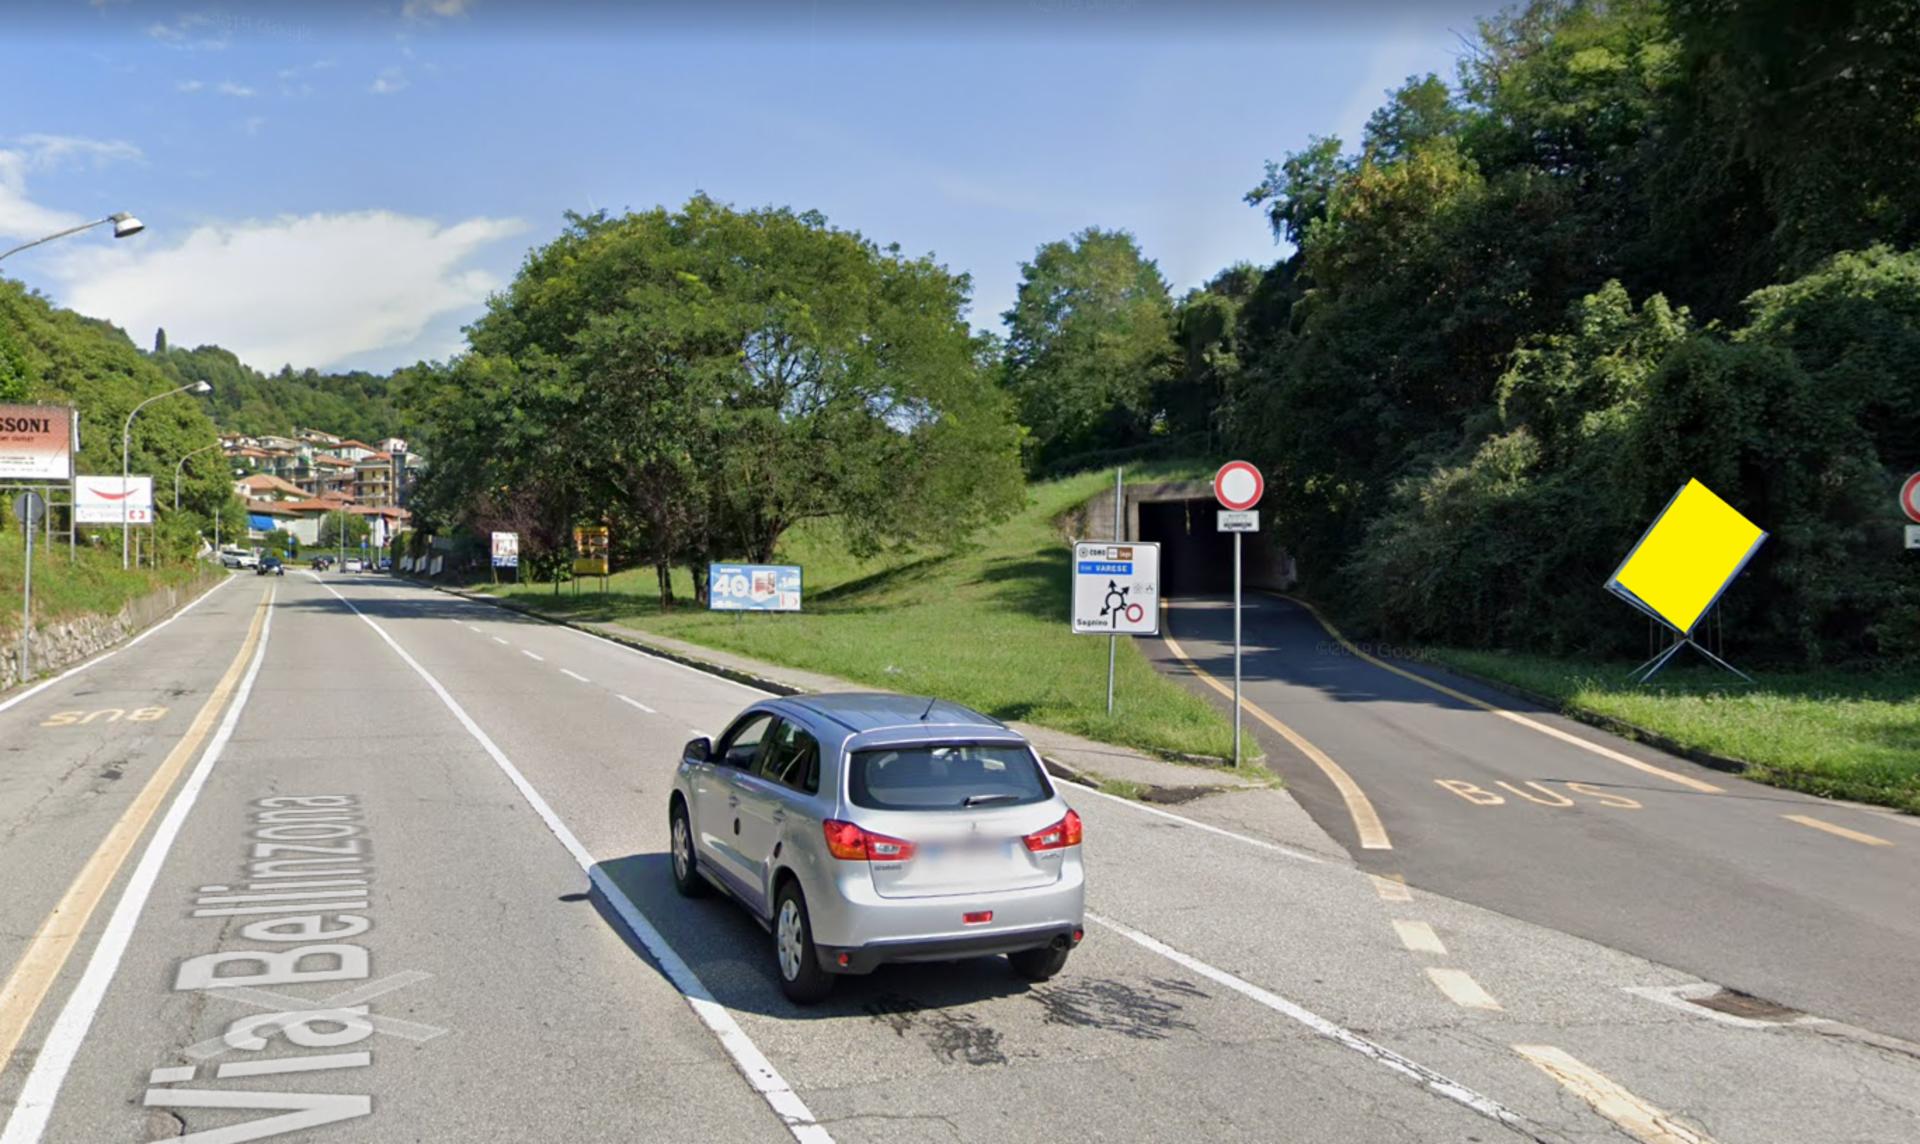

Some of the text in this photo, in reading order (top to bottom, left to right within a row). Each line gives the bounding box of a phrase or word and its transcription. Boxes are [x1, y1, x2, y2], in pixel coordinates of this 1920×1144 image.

[1095, 564, 1129, 572] VARESE
[713, 574, 750, 598] 40
[39, 704, 171, 727] BUS
[1433, 779, 1643, 809] BUS
